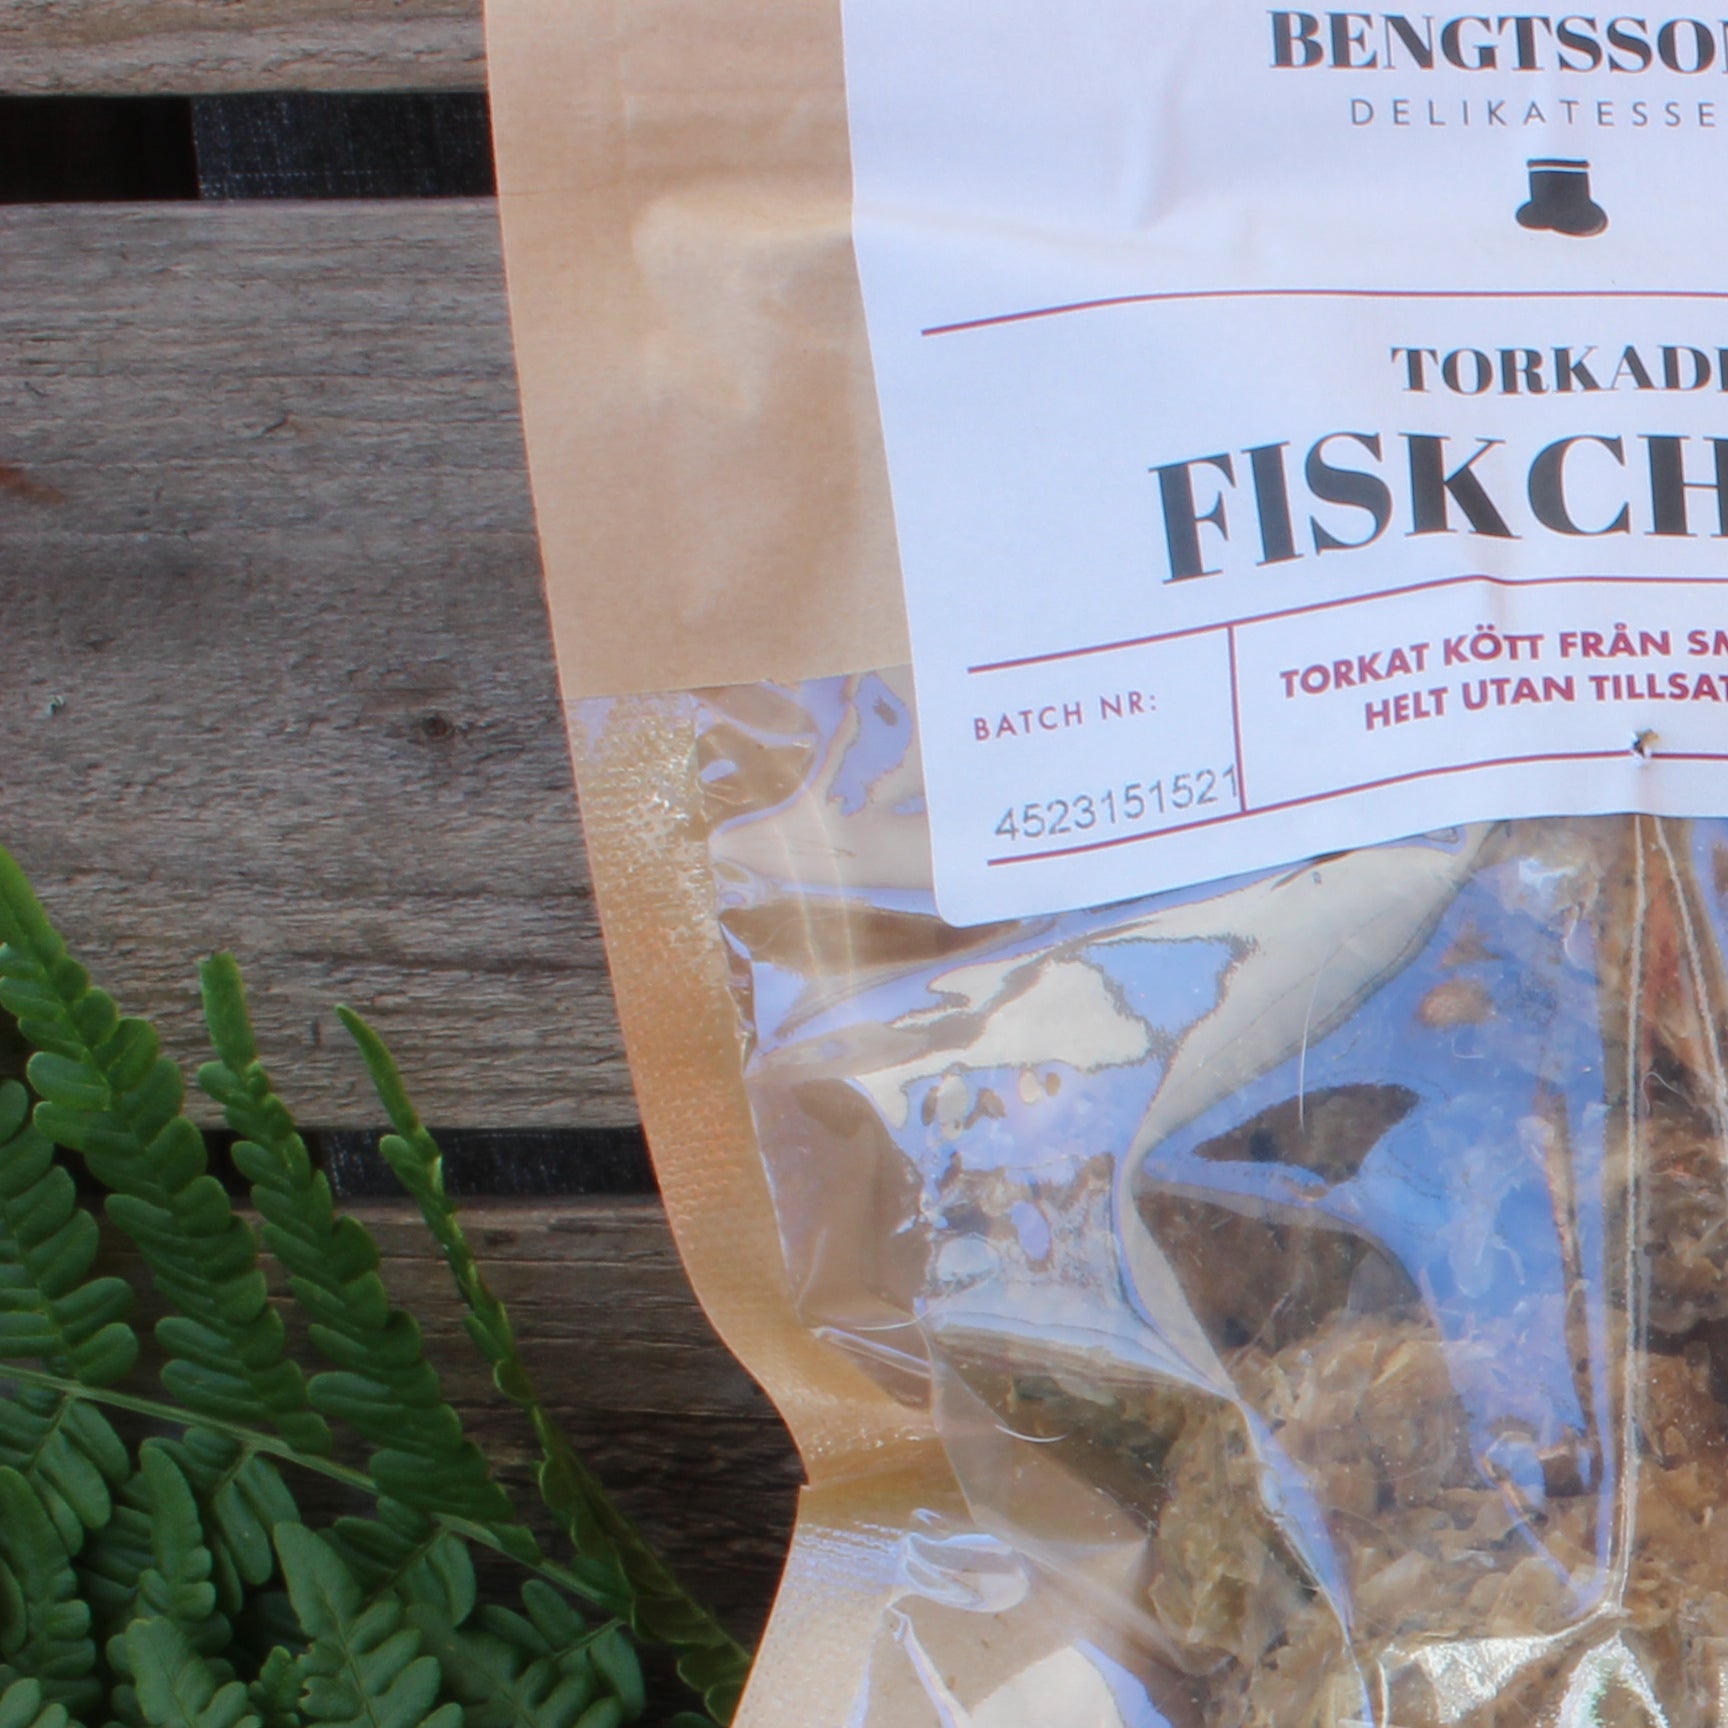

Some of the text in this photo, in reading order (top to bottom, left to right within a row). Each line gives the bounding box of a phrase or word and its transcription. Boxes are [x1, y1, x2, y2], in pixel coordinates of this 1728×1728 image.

[1280, 642, 1430, 699] TORKAT
[1443, 624, 1545, 668] KÖTT
[1559, 623, 1672, 659] FRÅN
[973, 690, 1157, 741] BATCH NR:
[1364, 687, 1448, 732] HELT
[1462, 676, 1575, 712] UTAN
[994, 764, 1239, 841] 4523151521
